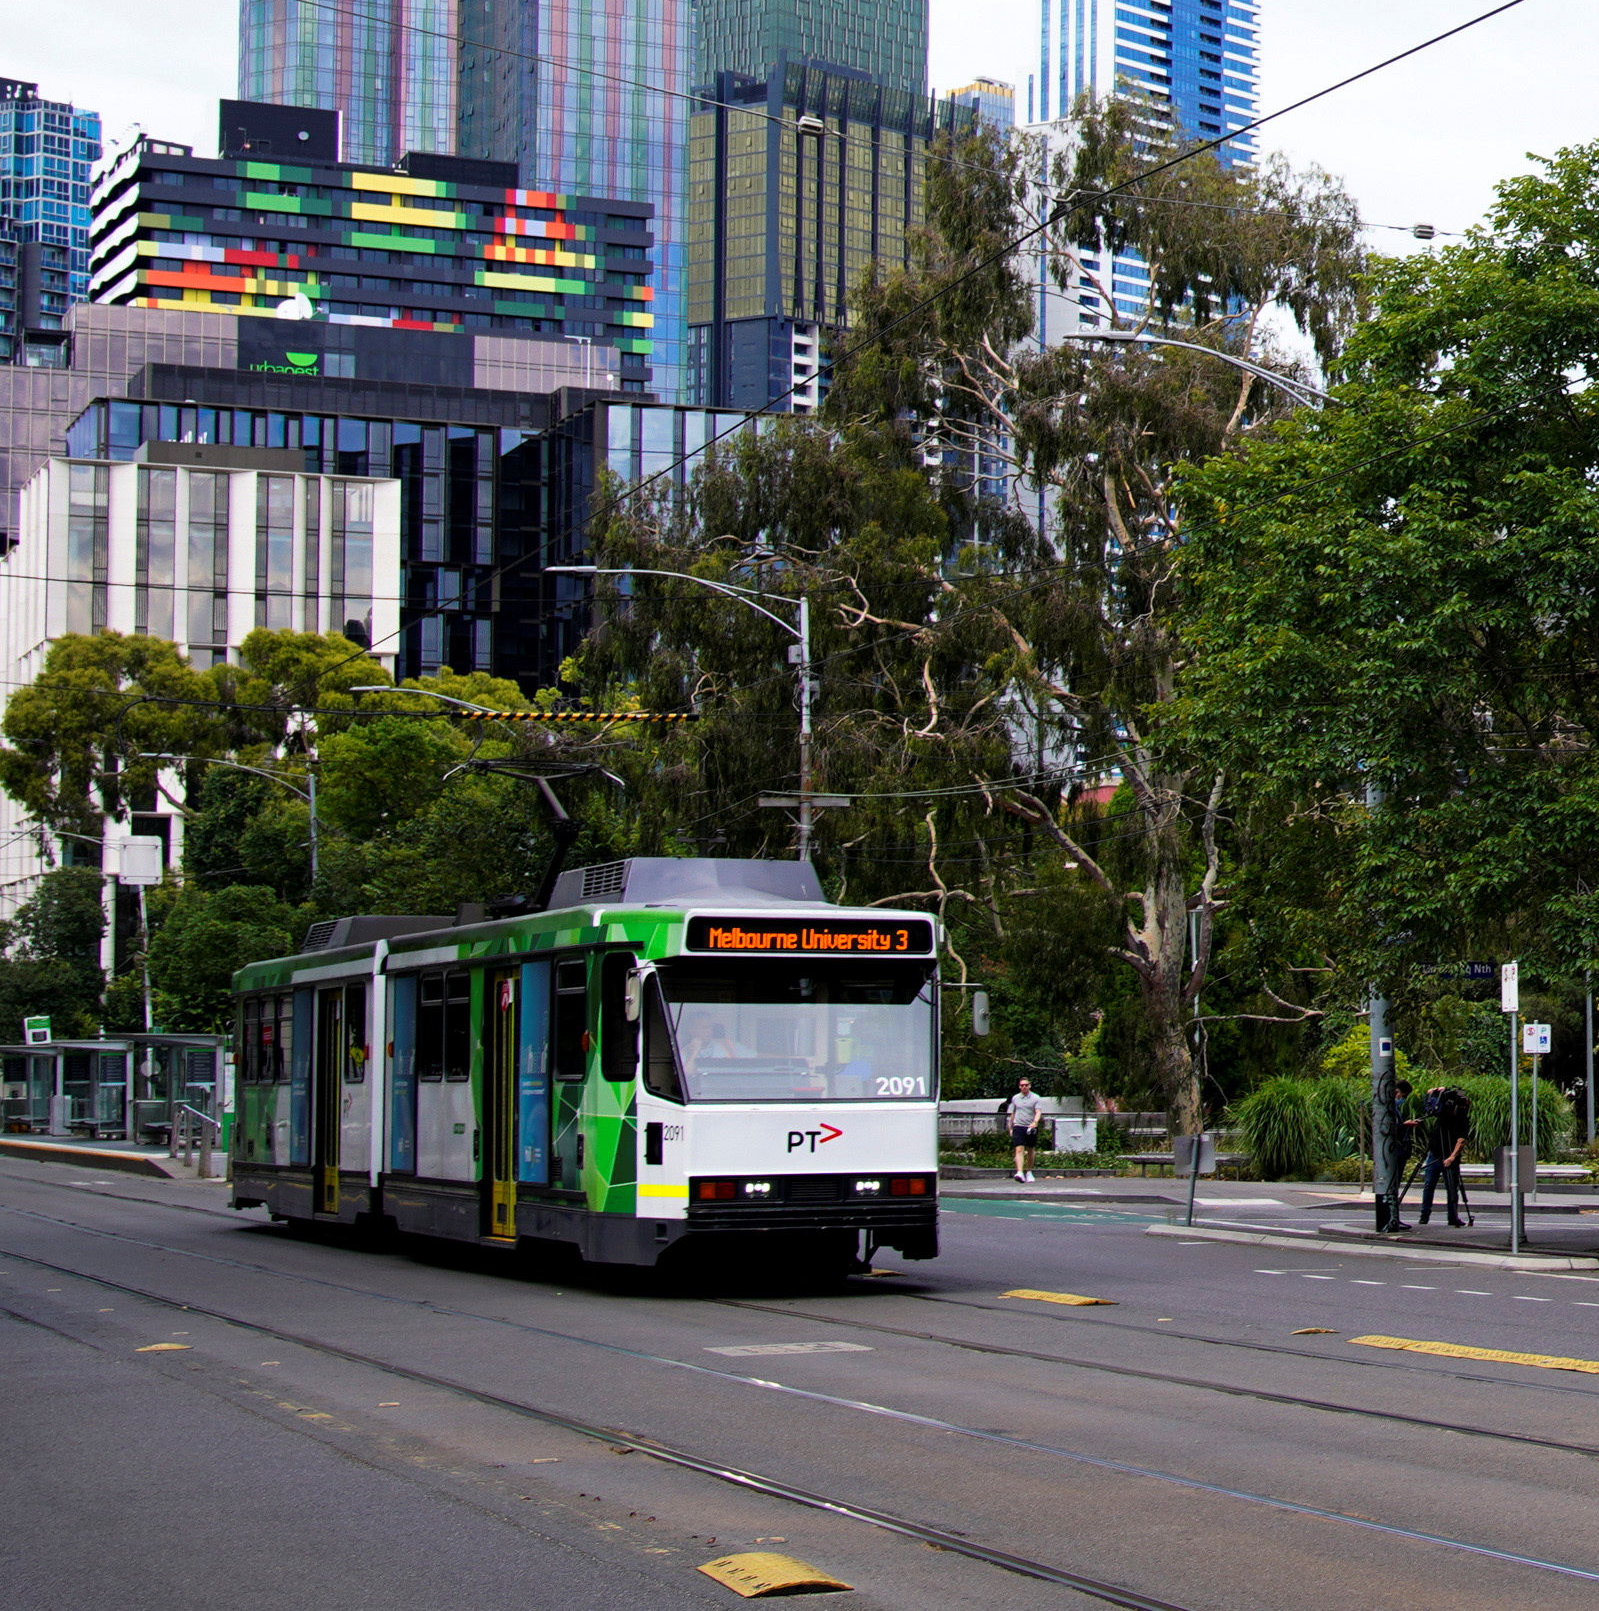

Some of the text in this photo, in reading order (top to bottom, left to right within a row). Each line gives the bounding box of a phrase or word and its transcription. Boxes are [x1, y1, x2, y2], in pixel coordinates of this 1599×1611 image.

[709, 928, 908, 950] Melbourne University 3
[1474, 964, 1492, 974] Nth
[876, 1076, 926, 1096] 2091
[664, 1125, 684, 1141] 2091
